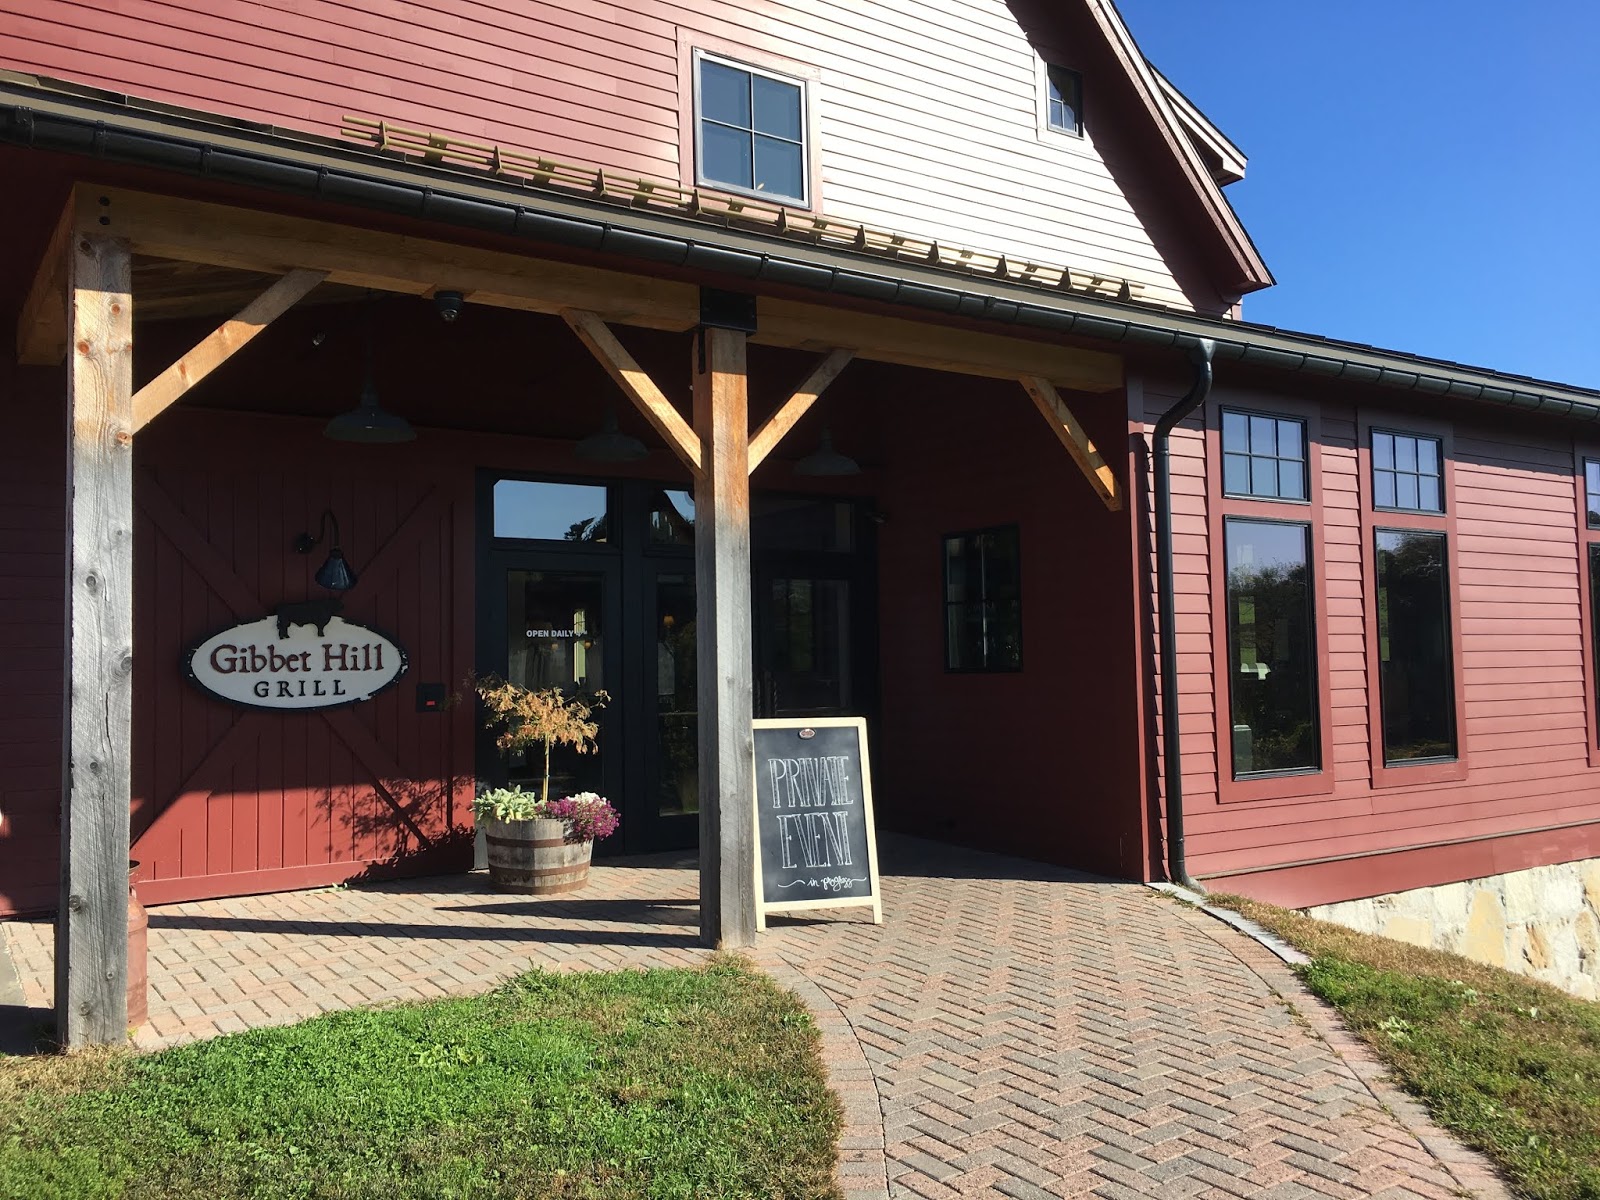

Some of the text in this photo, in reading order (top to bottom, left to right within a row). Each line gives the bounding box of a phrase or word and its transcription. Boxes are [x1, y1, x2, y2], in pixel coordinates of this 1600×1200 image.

[526, 629, 549, 638] OPEN
[551, 629, 574, 638] DAILY
[210, 643, 384, 674] Gibbet Hill
[253, 679, 346, 698] GRILL
[768, 756, 854, 808] PRIVATE
[776, 811, 853, 868] EVENT
[807, 877, 820, 887] in
